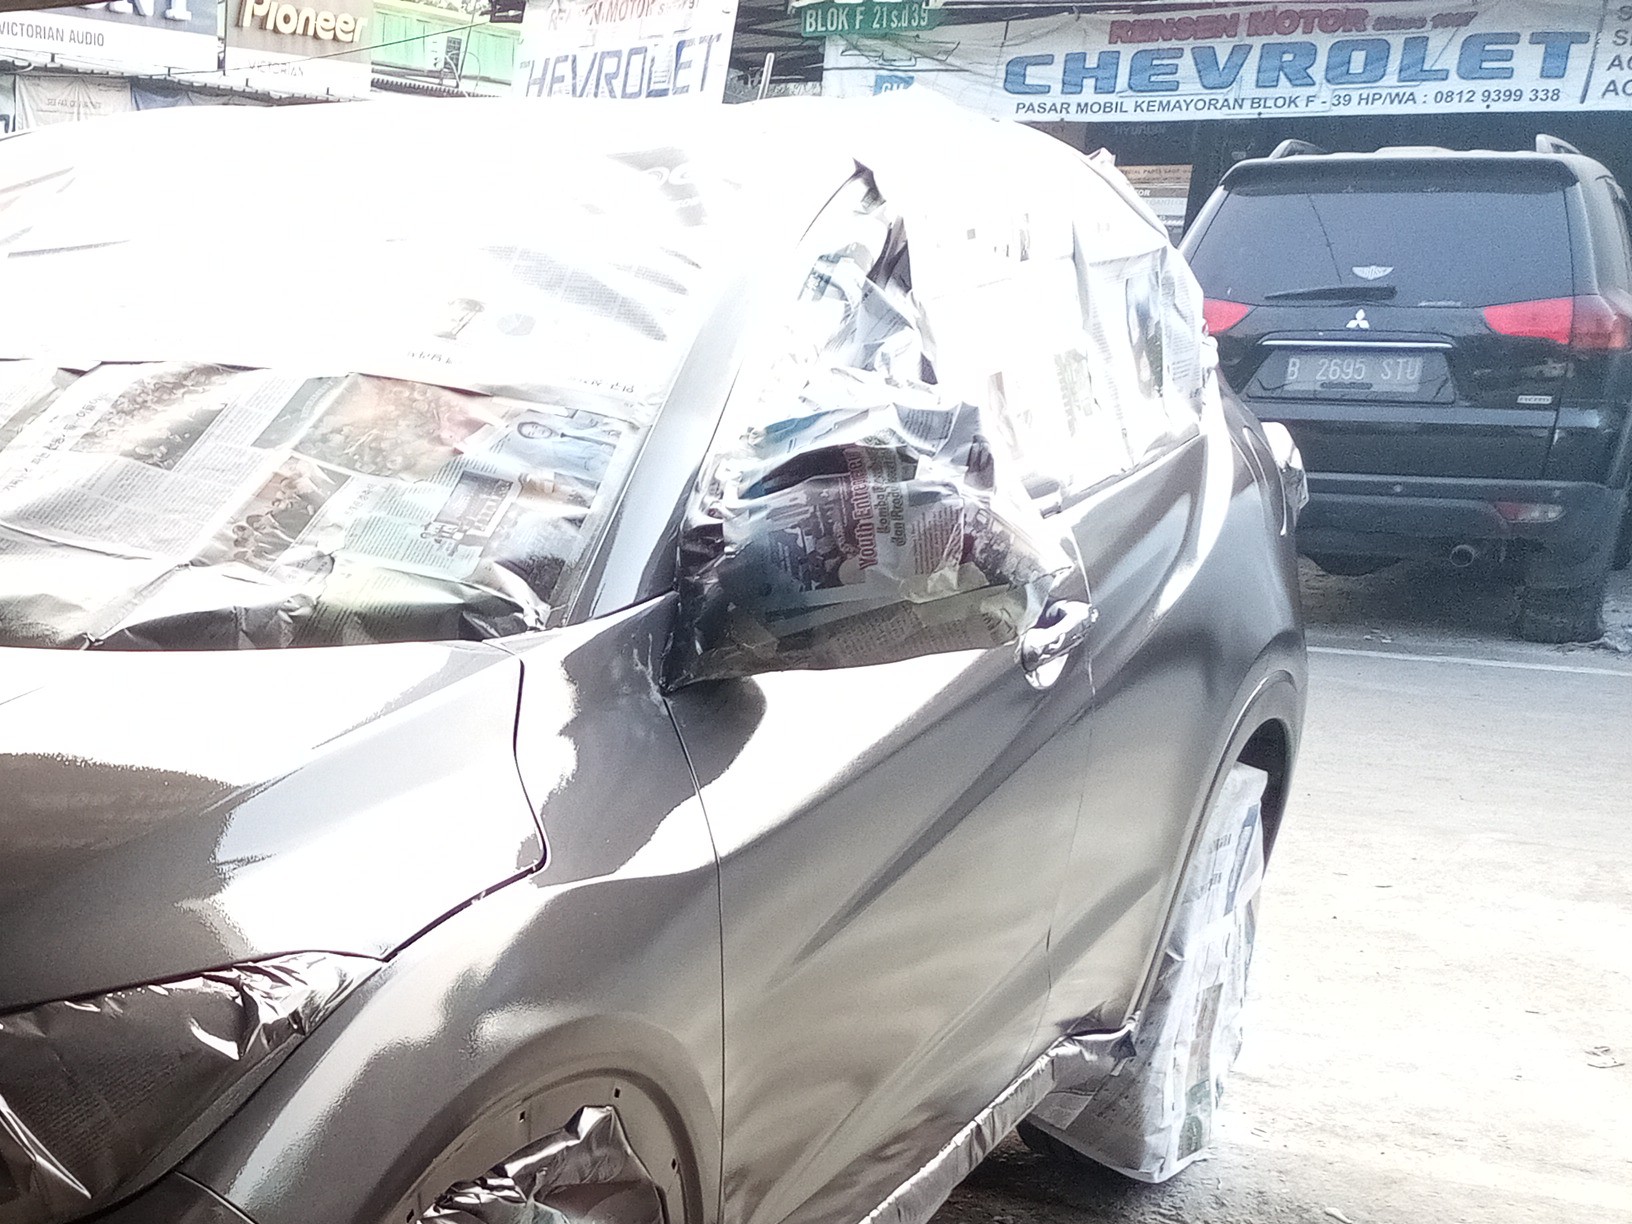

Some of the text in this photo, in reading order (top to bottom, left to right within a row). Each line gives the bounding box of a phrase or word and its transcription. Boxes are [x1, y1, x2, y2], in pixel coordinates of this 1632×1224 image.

[68, 29, 105, 47] AUDIO
[240, 0, 367, 43] Pioneer
[805, 9, 849, 32] BLOK
[855, 7, 866, 29] F
[872, 8, 887, 29] 21
[911, 7, 929, 27] 39
[1108, 14, 1240, 44] RENSEN
[1247, 8, 1369, 38] MOTOR
[520, 33, 722, 99] HEVROLET
[1003, 31, 1592, 95] CHEVROLET
[1015, 101, 1070, 115] PASAR
[1075, 100, 1128, 114] MOBIL
[1133, 98, 1245, 113] KEMAYORAN
[1250, 96, 1300, 110] BLOK
[1305, 94, 1316, 108] F
[1331, 93, 1352, 106] 39
[1357, 91, 1417, 106] HP/WA
[1434, 90, 1475, 104] 0812
[1481, 88, 1523, 103] 9399
[1529, 87, 1561, 102] 338
[1286, 357, 1300, 380] B
[1315, 357, 1367, 381] 2695
[873, 494, 890, 534] Lomba
[855, 522, 878, 571] Youth
